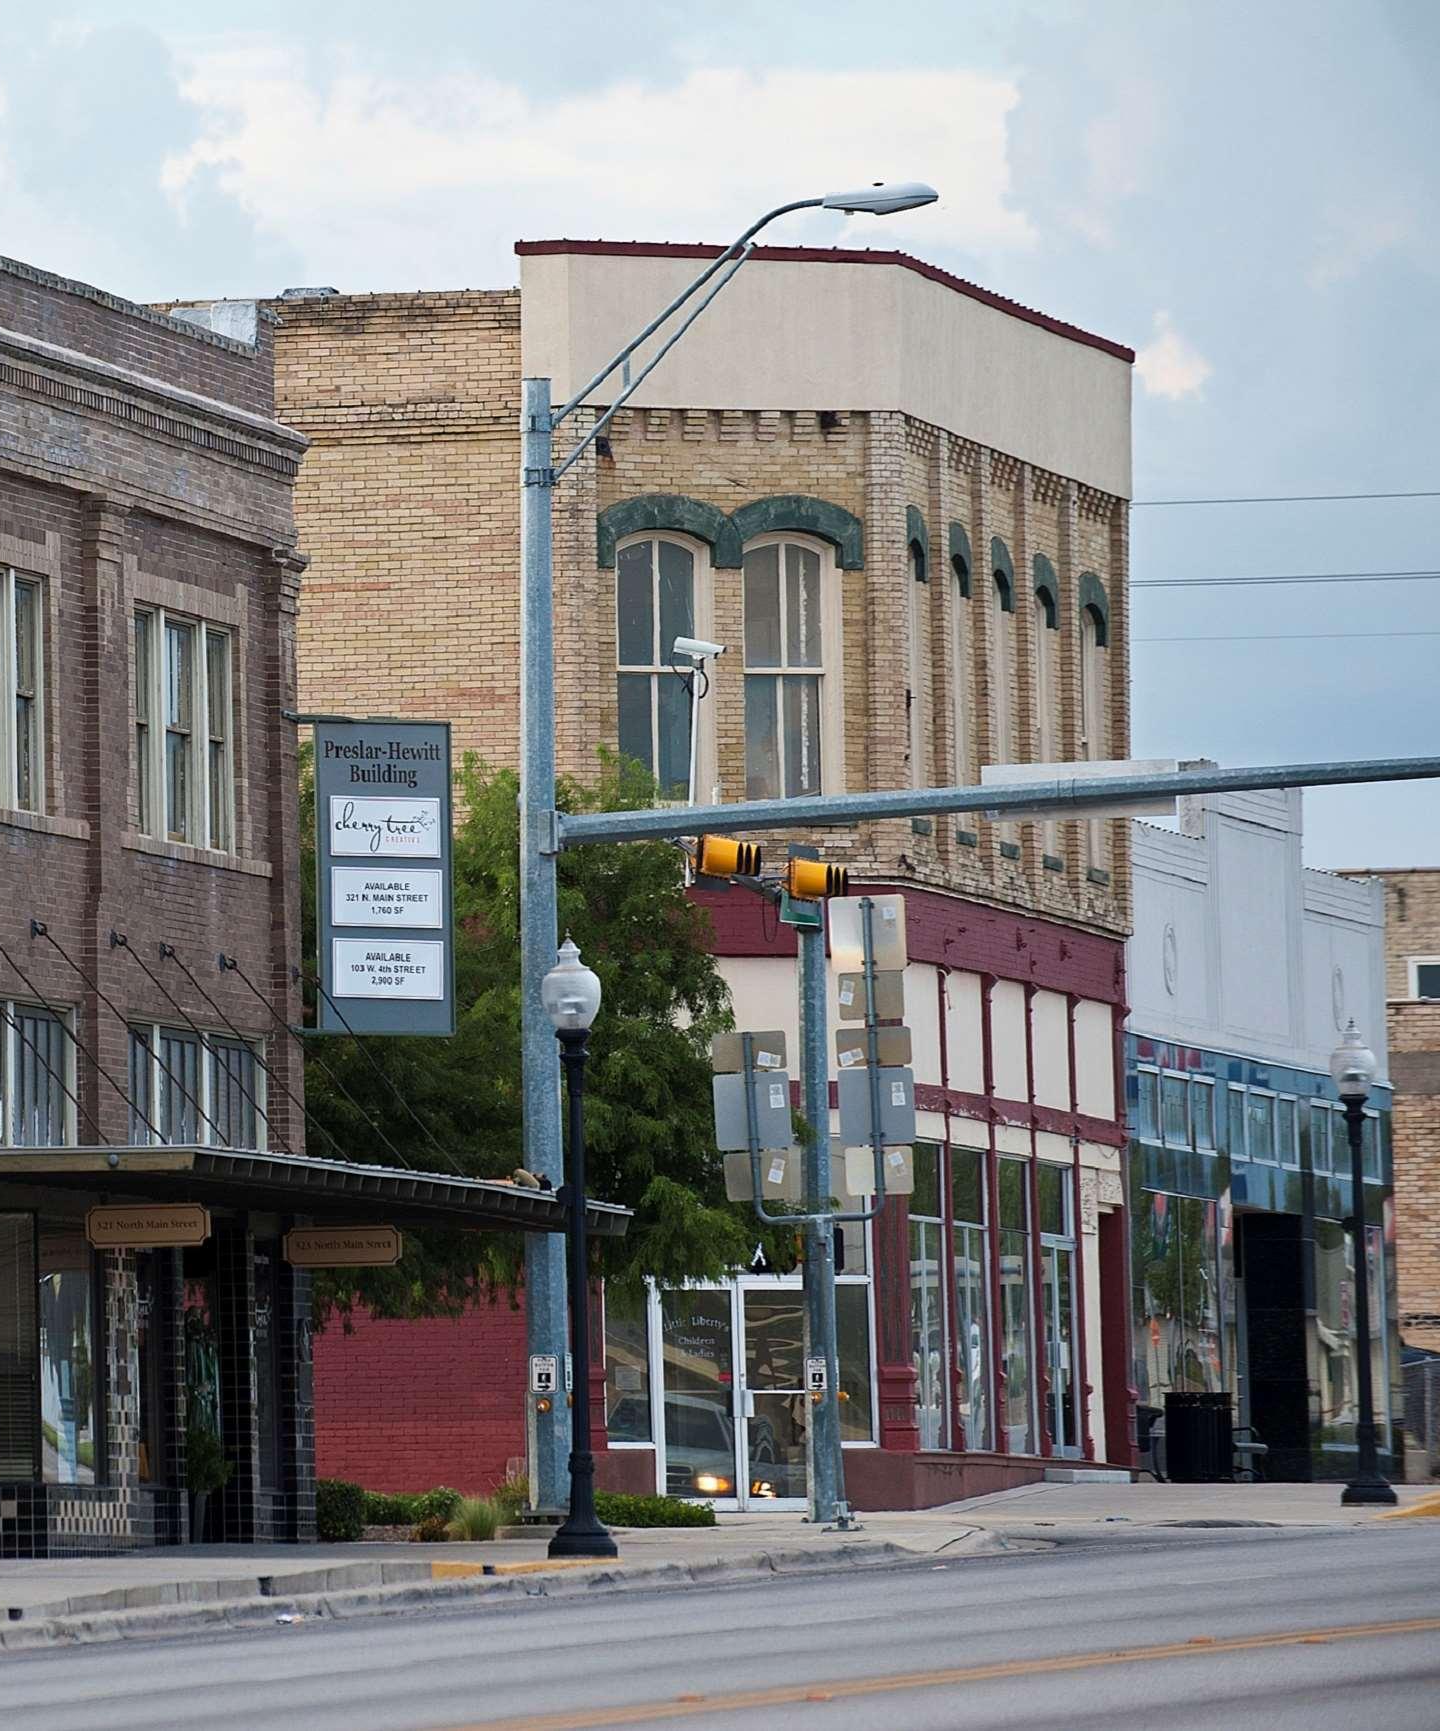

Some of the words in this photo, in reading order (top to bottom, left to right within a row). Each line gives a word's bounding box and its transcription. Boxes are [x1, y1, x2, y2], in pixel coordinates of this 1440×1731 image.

[324, 740, 441, 761] Preslar-Hewitt
[350, 764, 418, 788] Building
[335, 801, 382, 852] cherry
[382, 815, 422, 835] tree
[364, 882, 411, 891] AVAILABLE
[345, 893, 359, 902] 321
[372, 894, 394, 902] MAIN
[396, 894, 429, 903] STREET
[394, 906, 404, 914] SF
[365, 952, 411, 962] AVAILABLE
[378, 965, 392, 973] 4th
[393, 965, 426, 974] STREET
[394, 977, 405, 985] SF
[116, 1220, 144, 1230] North
[146, 1220, 168, 1229] Main
[170, 1220, 198, 1229] Street
[314, 1240, 341, 1249] North
[343, 1239, 364, 1249] Main
[367, 1240, 391, 1249] Street
